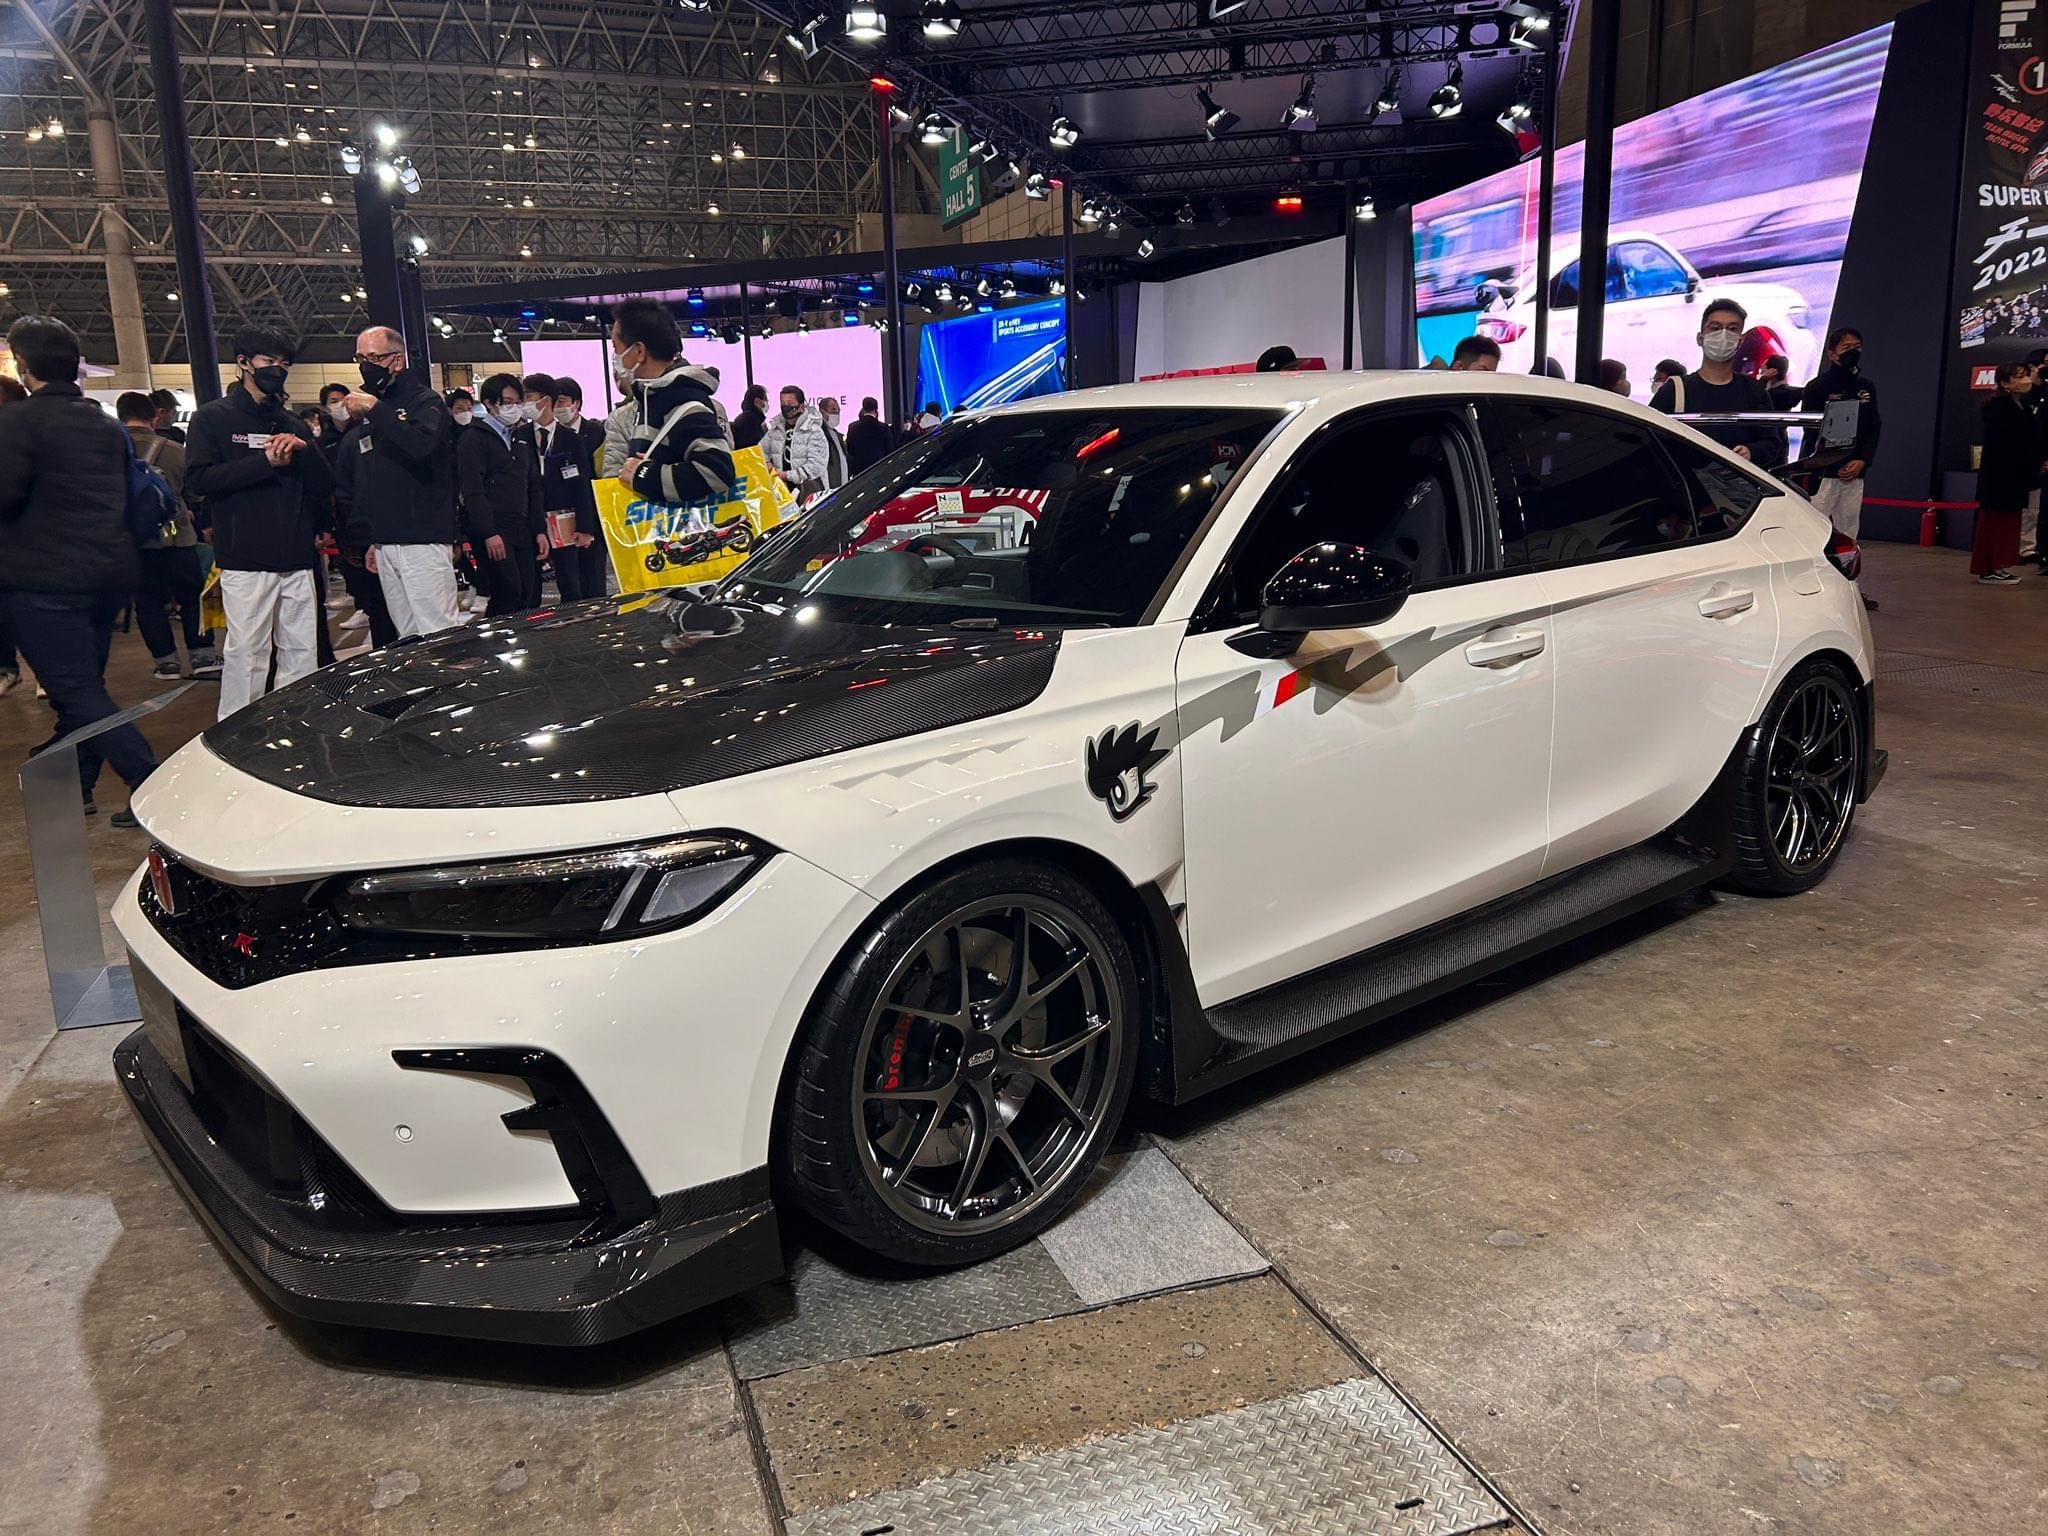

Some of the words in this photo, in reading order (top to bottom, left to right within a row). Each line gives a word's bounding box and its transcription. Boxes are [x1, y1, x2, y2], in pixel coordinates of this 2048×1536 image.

[949, 158, 968, 181] CENTER
[945, 190, 965, 217] HALL
[966, 173, 975, 207] 5
[1978, 184, 2042, 206] SUPER
[1973, 246, 2047, 291] 2022
